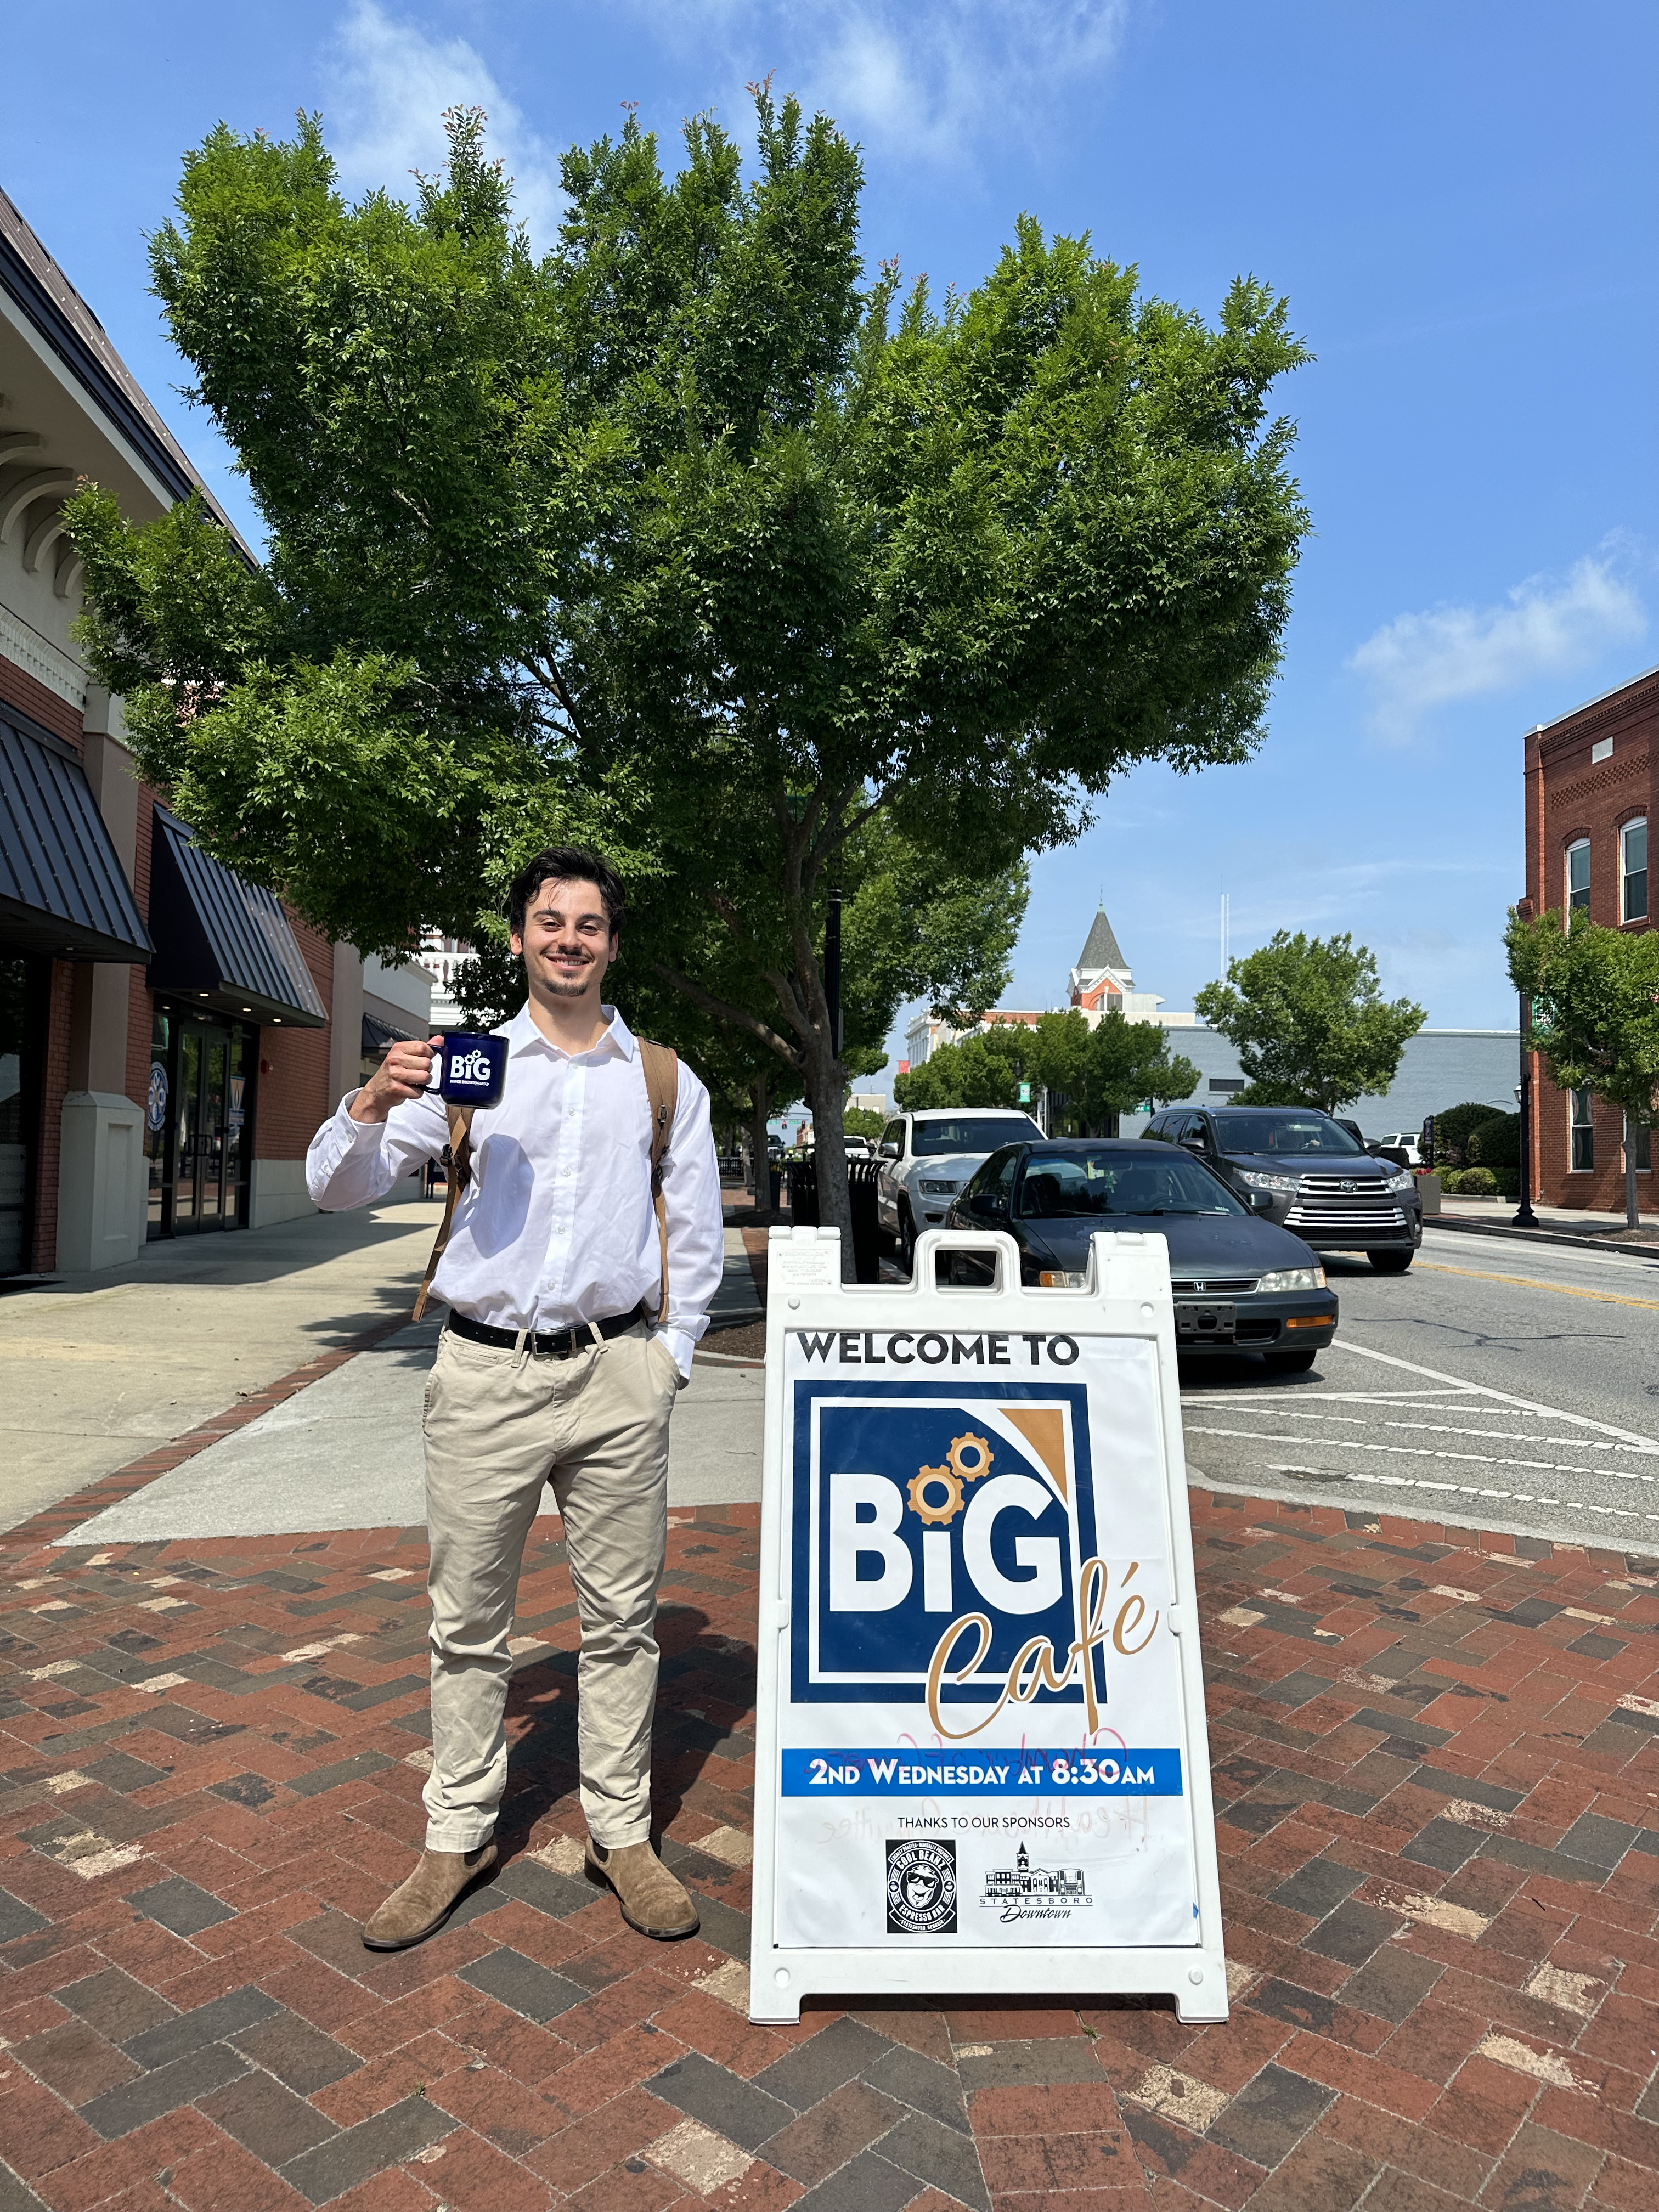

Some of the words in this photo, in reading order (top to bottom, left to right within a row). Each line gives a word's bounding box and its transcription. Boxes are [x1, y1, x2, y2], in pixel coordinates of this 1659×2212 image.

[797, 1331, 1011, 1365] WELCOME
[1022, 1334, 1080, 1366] TO
[928, 1559, 1159, 1740] Café
[898, 1816, 948, 1828] THANKS
[951, 1817, 968, 1828] TO
[972, 1817, 999, 1828] OUR
[1002, 1817, 1070, 1828] SPONSORS
[896, 1851, 918, 1869] COOL
[919, 1850, 946, 1870] BEANZ
[899, 1904, 932, 1921] ESPRESSO
[931, 1904, 945, 1918] BAR
[1000, 1904, 1072, 1923] Downtown
